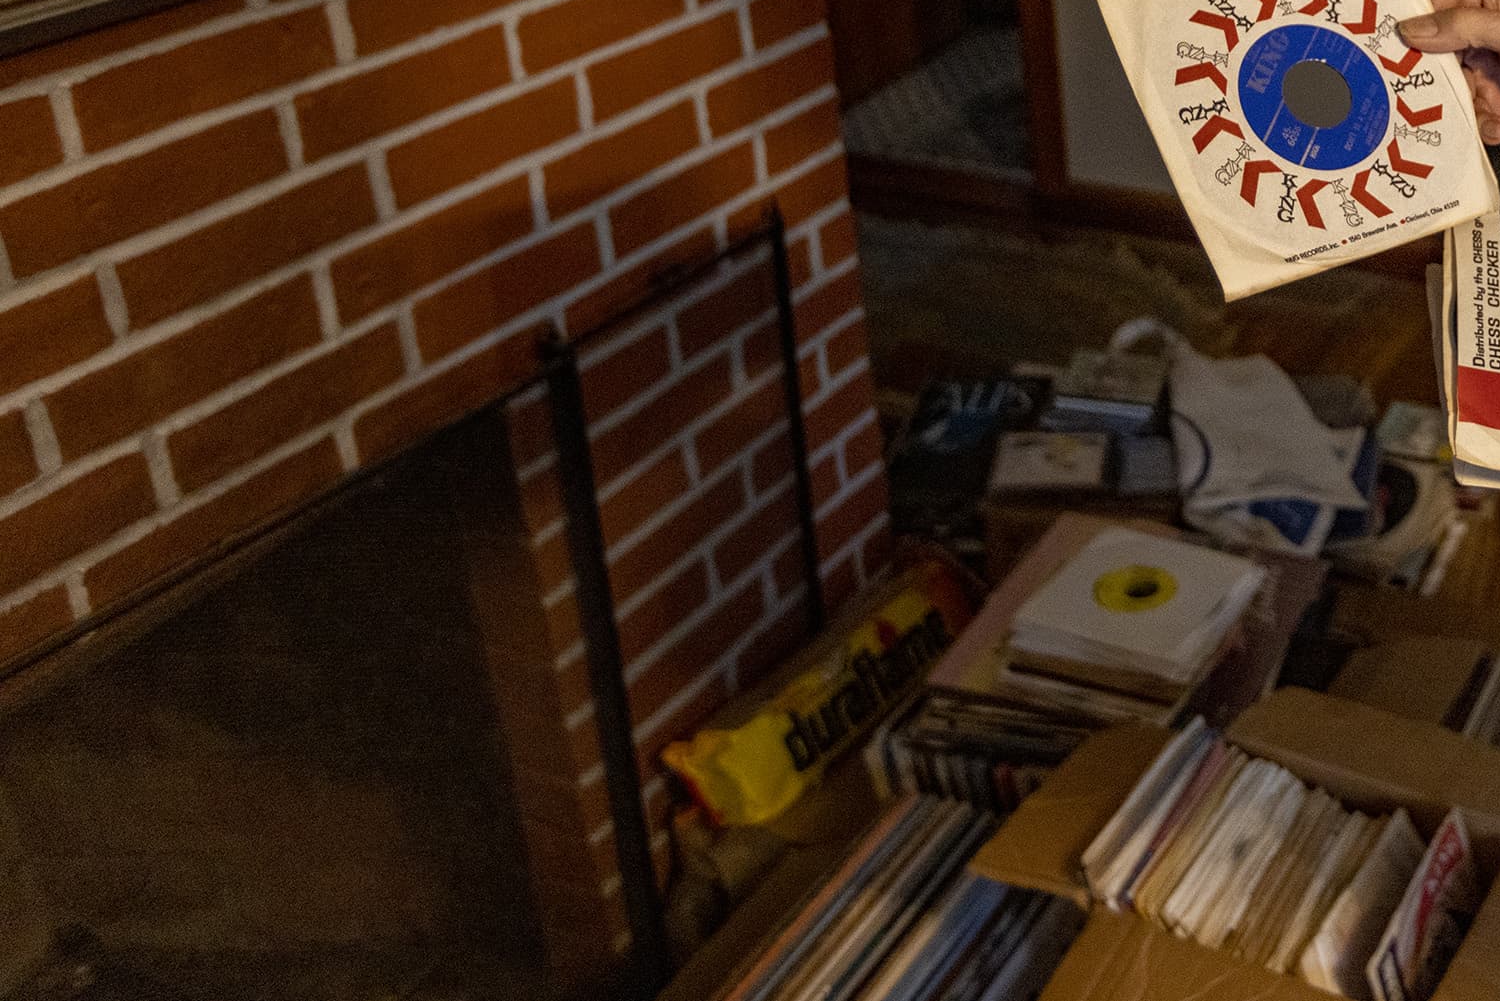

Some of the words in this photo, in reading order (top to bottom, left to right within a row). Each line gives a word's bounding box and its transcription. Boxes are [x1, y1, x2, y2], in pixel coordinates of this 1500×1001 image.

[1176, 41, 1229, 68] KING
[1246, 32, 1289, 93] KING
[1390, 69, 1434, 94] KING
[1179, 97, 1230, 125] KING
[1394, 121, 1441, 147] KING
[1214, 140, 1256, 186] KING
[1369, 158, 1417, 198] KING
[1277, 171, 1298, 223] KING
[1329, 177, 1363, 227] KING
[1472, 229, 1483, 264] CHESS
[1473, 266, 1483, 280] the
[1486, 240, 1500, 308] CHECKER
[1473, 288, 1486, 301] by
[1472, 303, 1485, 367] Distributed
[784, 610, 954, 771] duraflame
